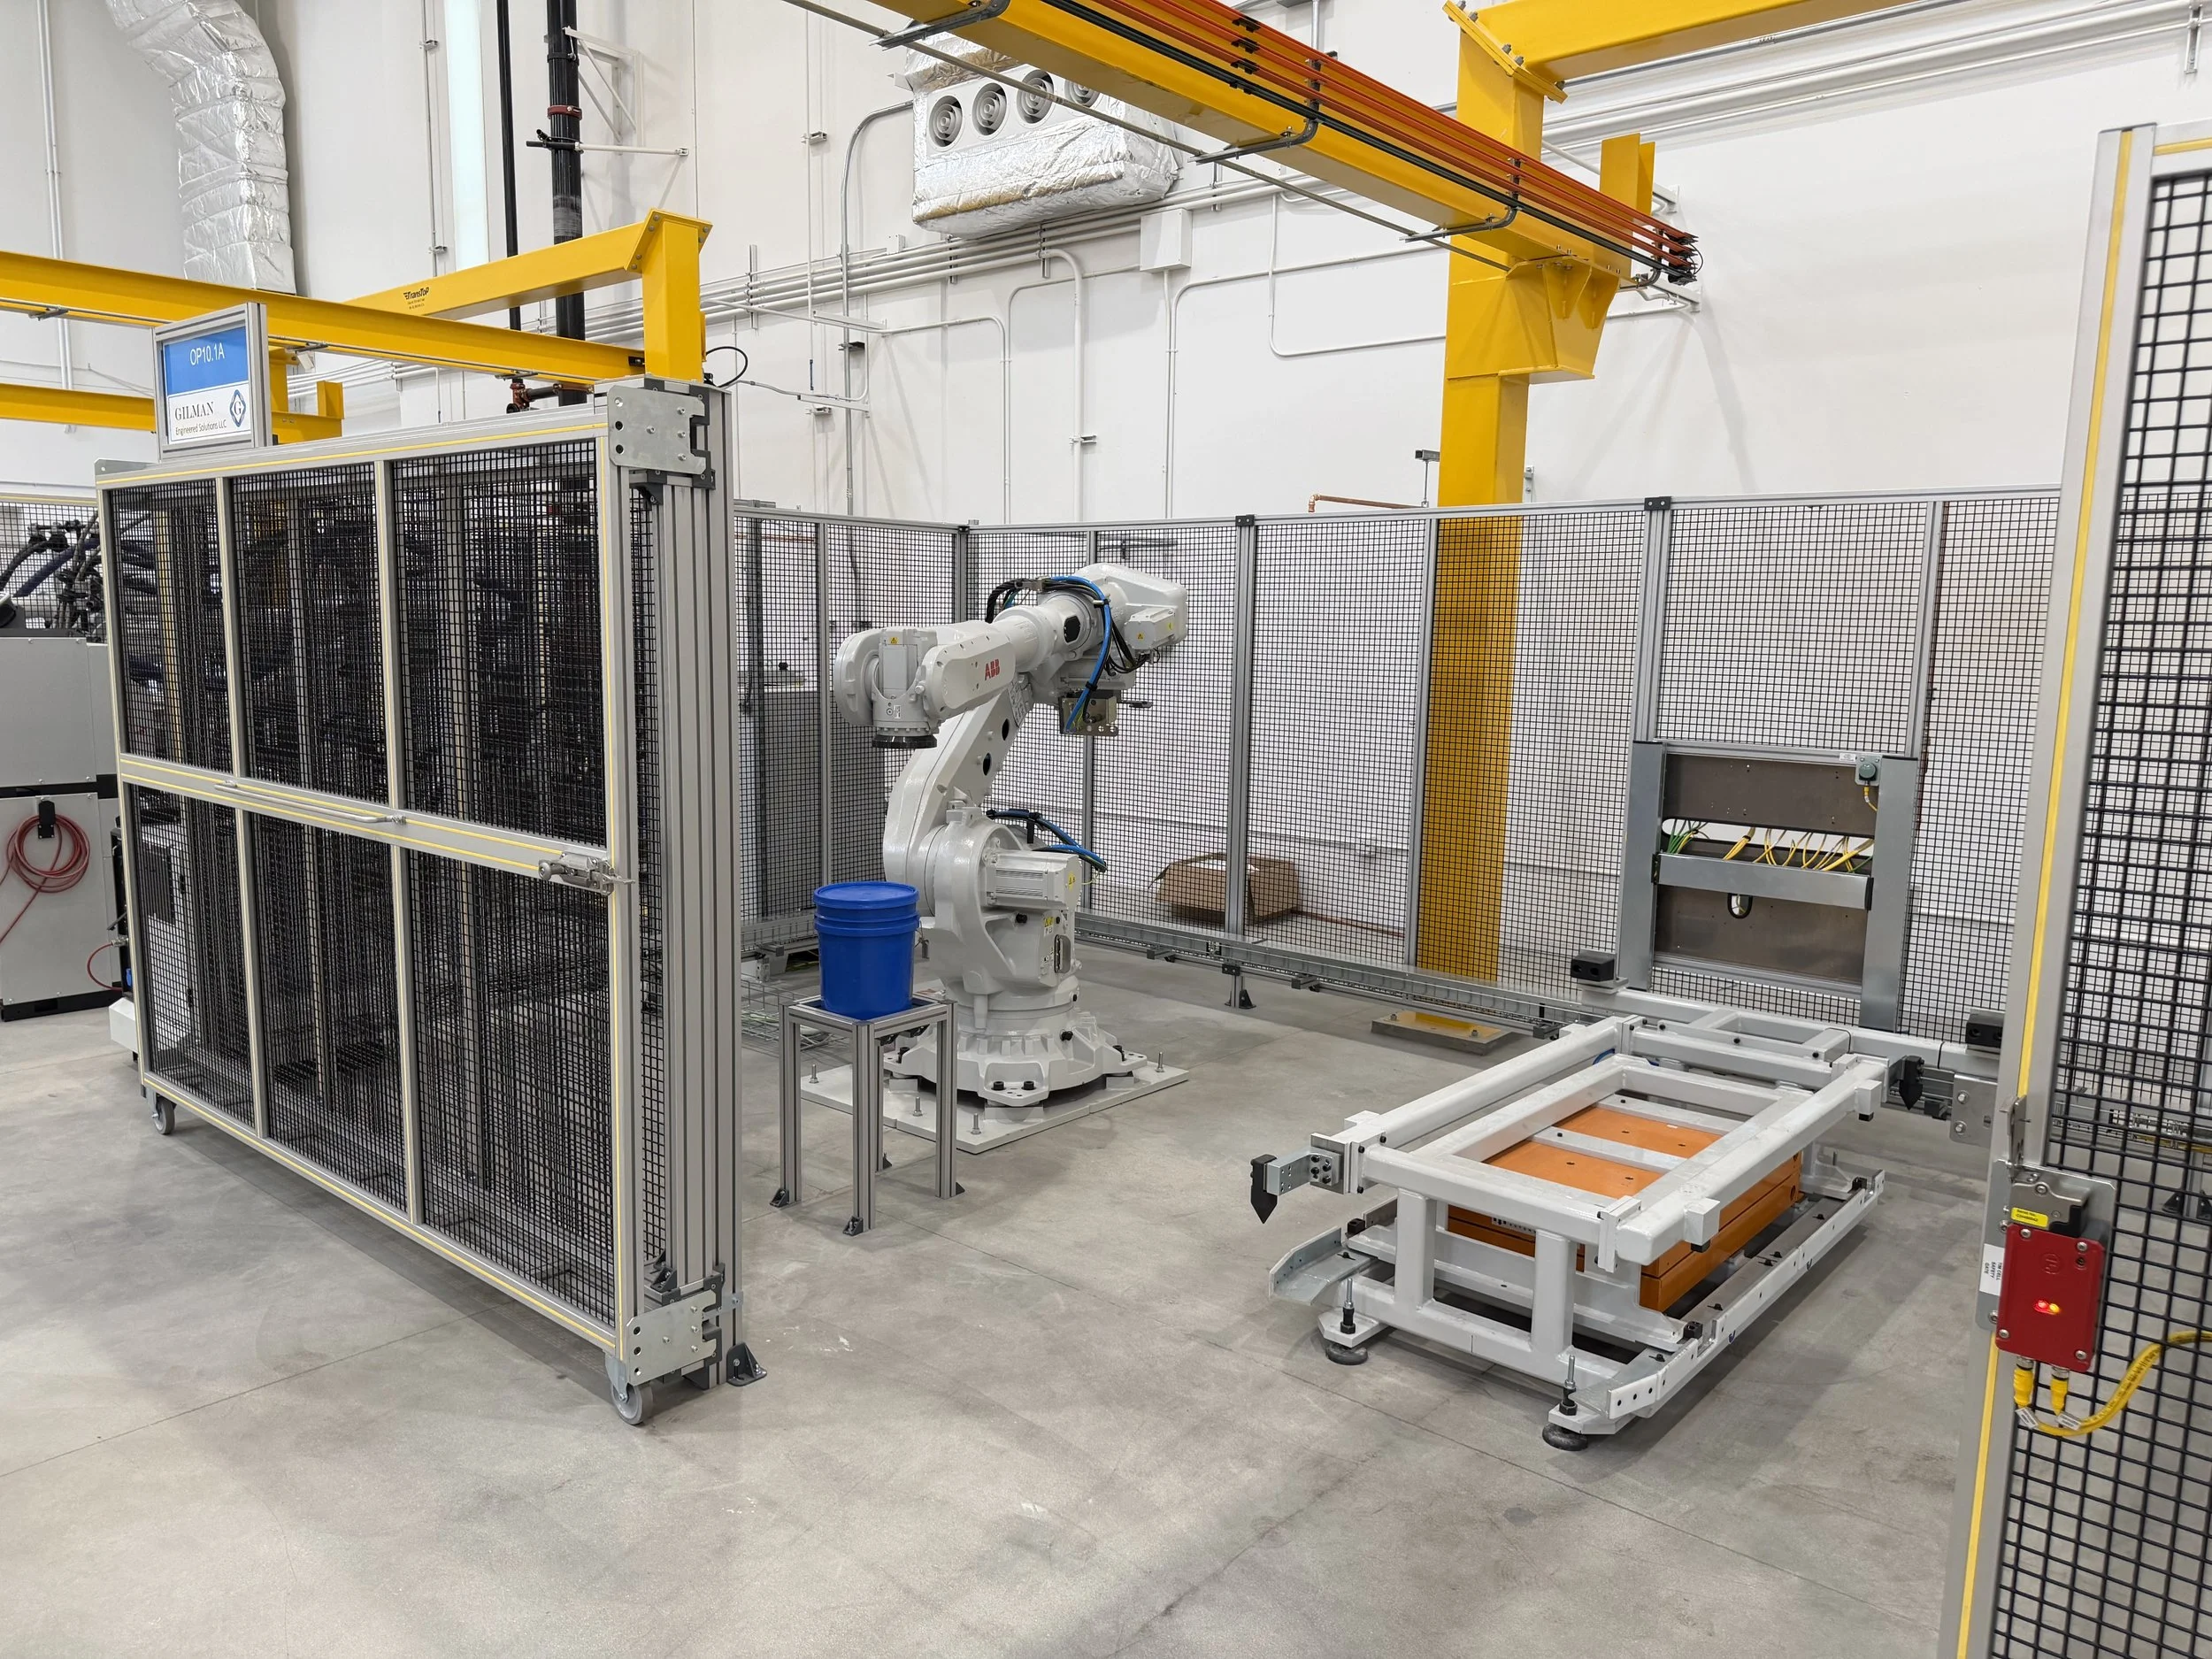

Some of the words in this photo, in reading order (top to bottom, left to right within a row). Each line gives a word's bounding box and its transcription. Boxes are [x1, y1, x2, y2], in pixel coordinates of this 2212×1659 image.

[189, 342, 225, 365] OP10.1A
[174, 401, 213, 420] GILMAN
[175, 424, 198, 436] Engineered
[199, 421, 218, 432] Solutions
[218, 419, 227, 429] LLC
[984, 658, 1000, 681] ABB
